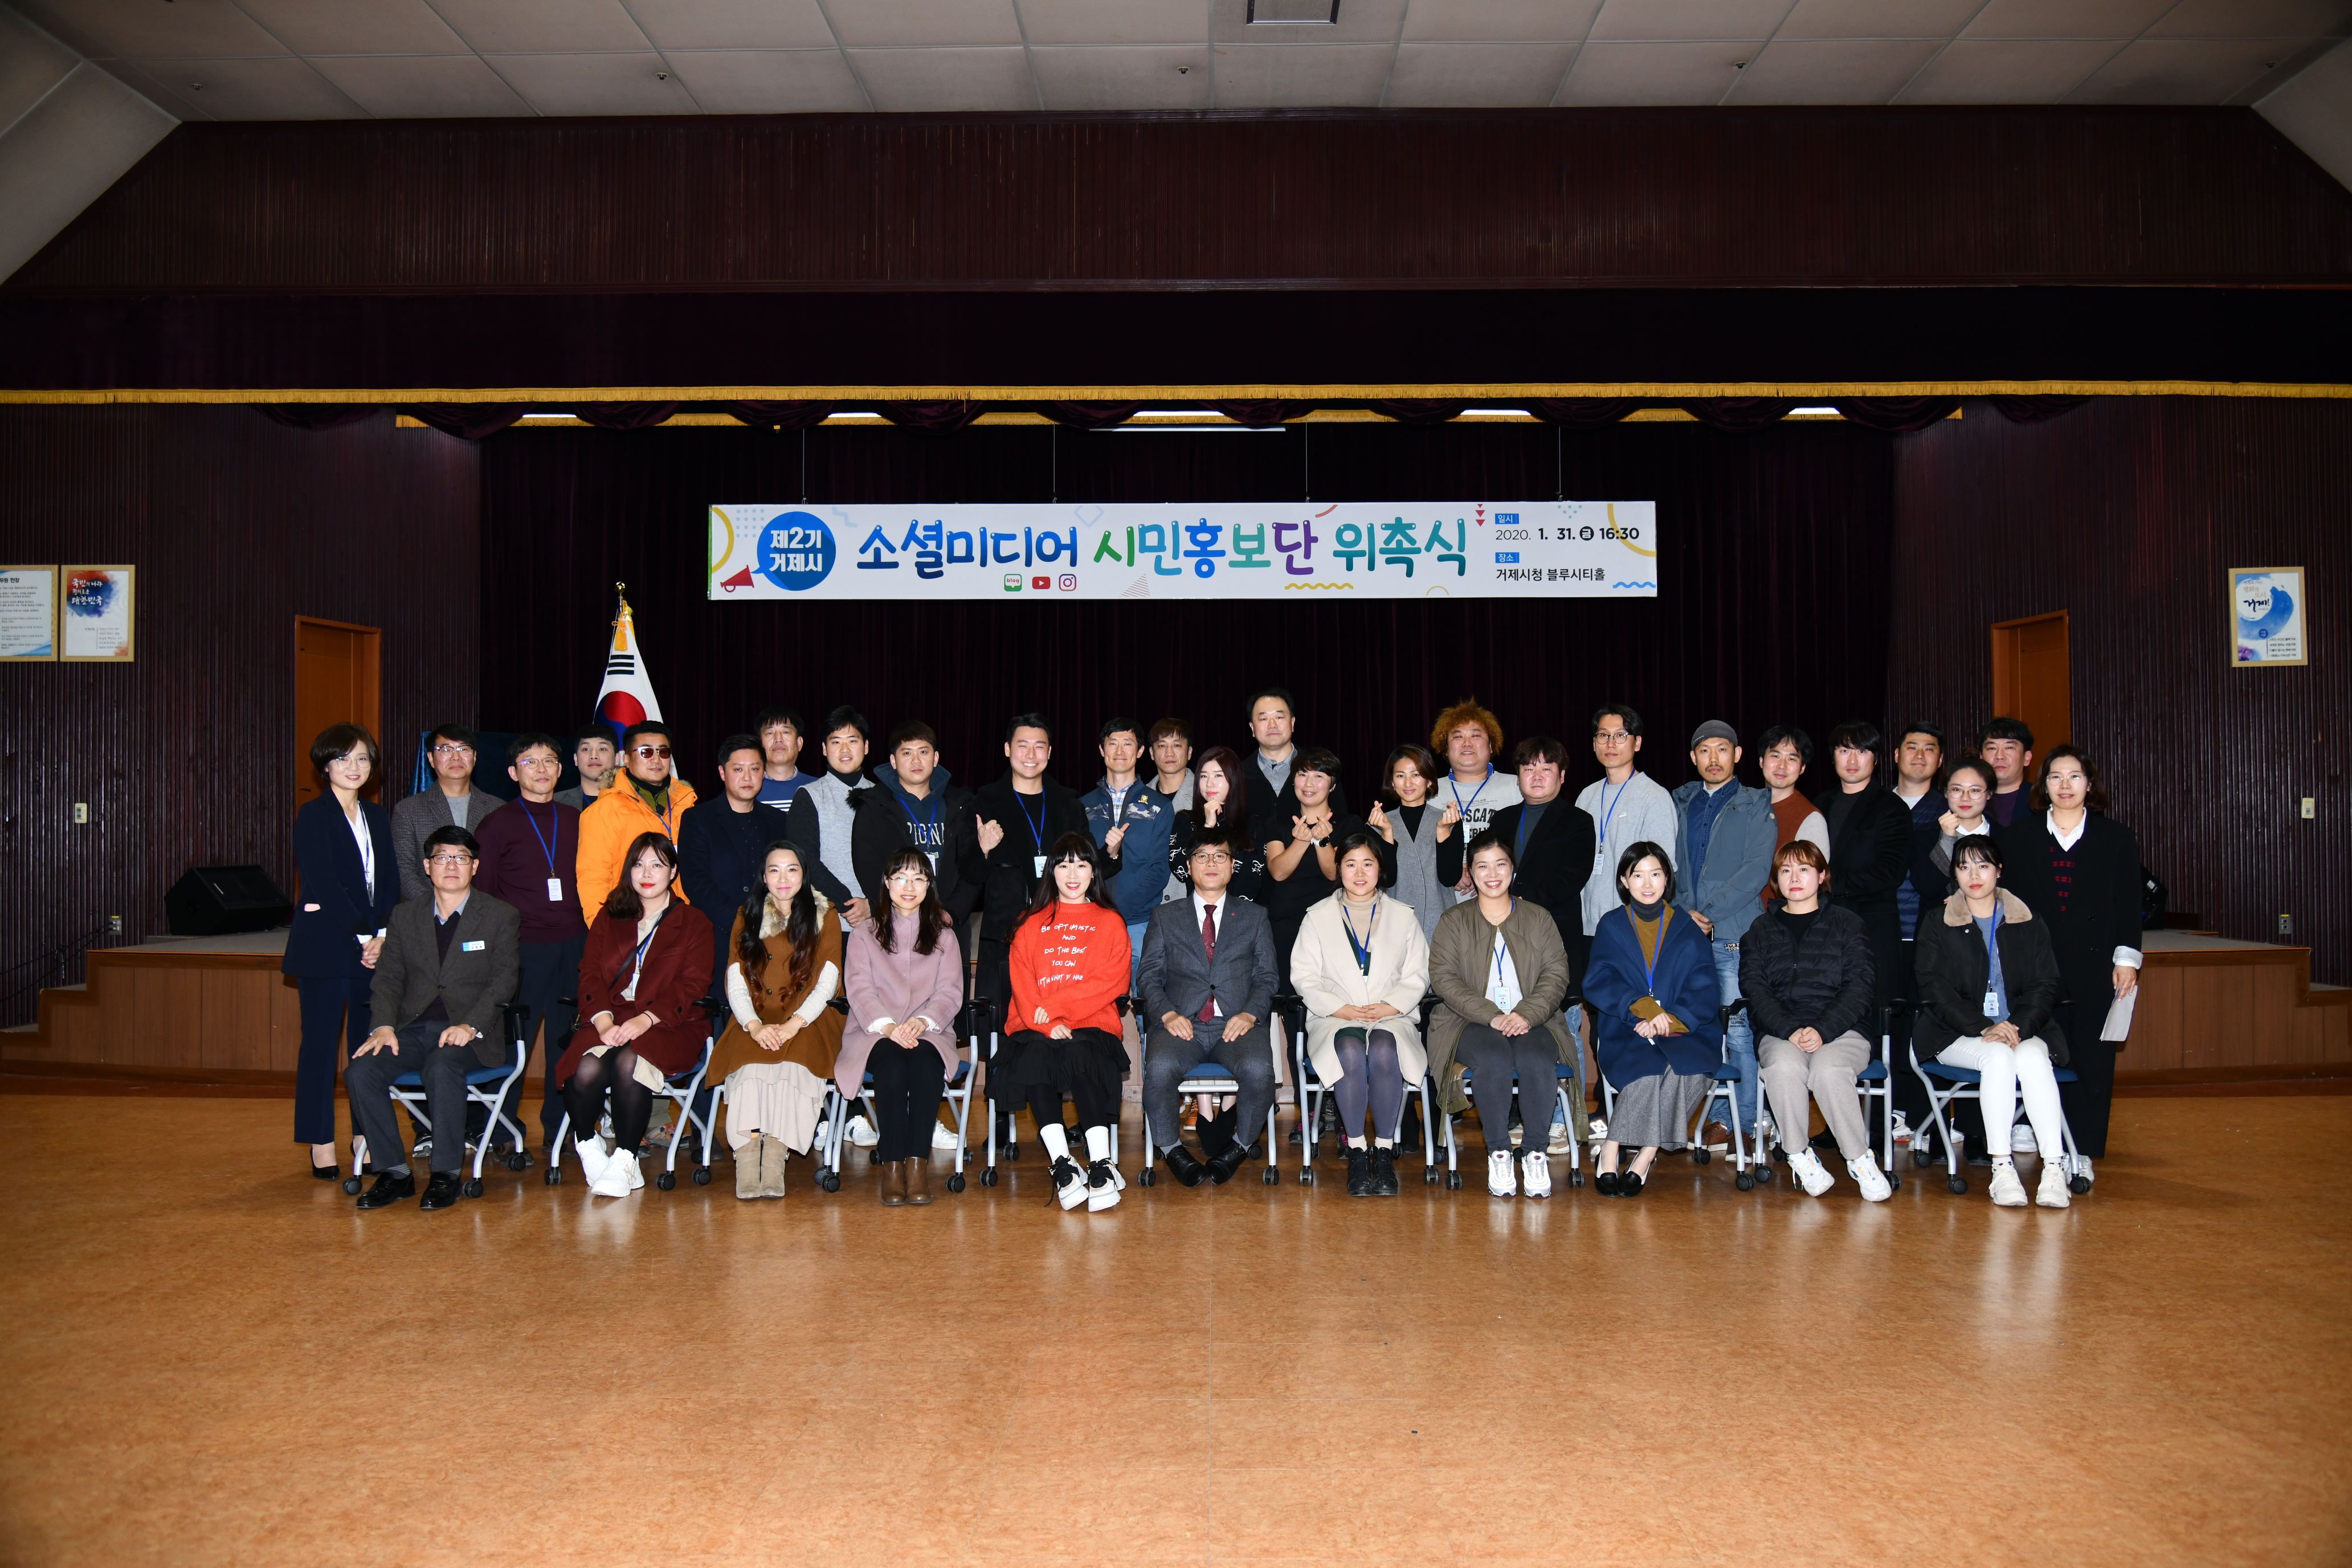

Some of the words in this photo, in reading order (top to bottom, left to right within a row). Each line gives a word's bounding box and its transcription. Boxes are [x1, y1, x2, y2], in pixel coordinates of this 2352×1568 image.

[1497, 514, 1513, 524] 일시
[770, 526, 822, 549] 제2기
[1496, 529, 1531, 540] 2020.
[1538, 528, 1548, 540] 1.
[1557, 528, 1575, 540] 31.
[1599, 528, 1639, 540] 16:30
[856, 519, 1078, 579] 소셜미디어
[1093, 517, 1319, 579] 시민홍보단
[1332, 516, 1466, 578] 위촉식
[769, 553, 822, 572] 거제시
[1498, 553, 1514, 562] 장소
[1496, 569, 1542, 581] 거제시청
[1546, 568, 1606, 581] 블루시티홀
[72, 595, 103, 606] 대한민국
[1054, 924, 1096, 933] OPTIMISTIC
[1057, 946, 1070, 956] THE
